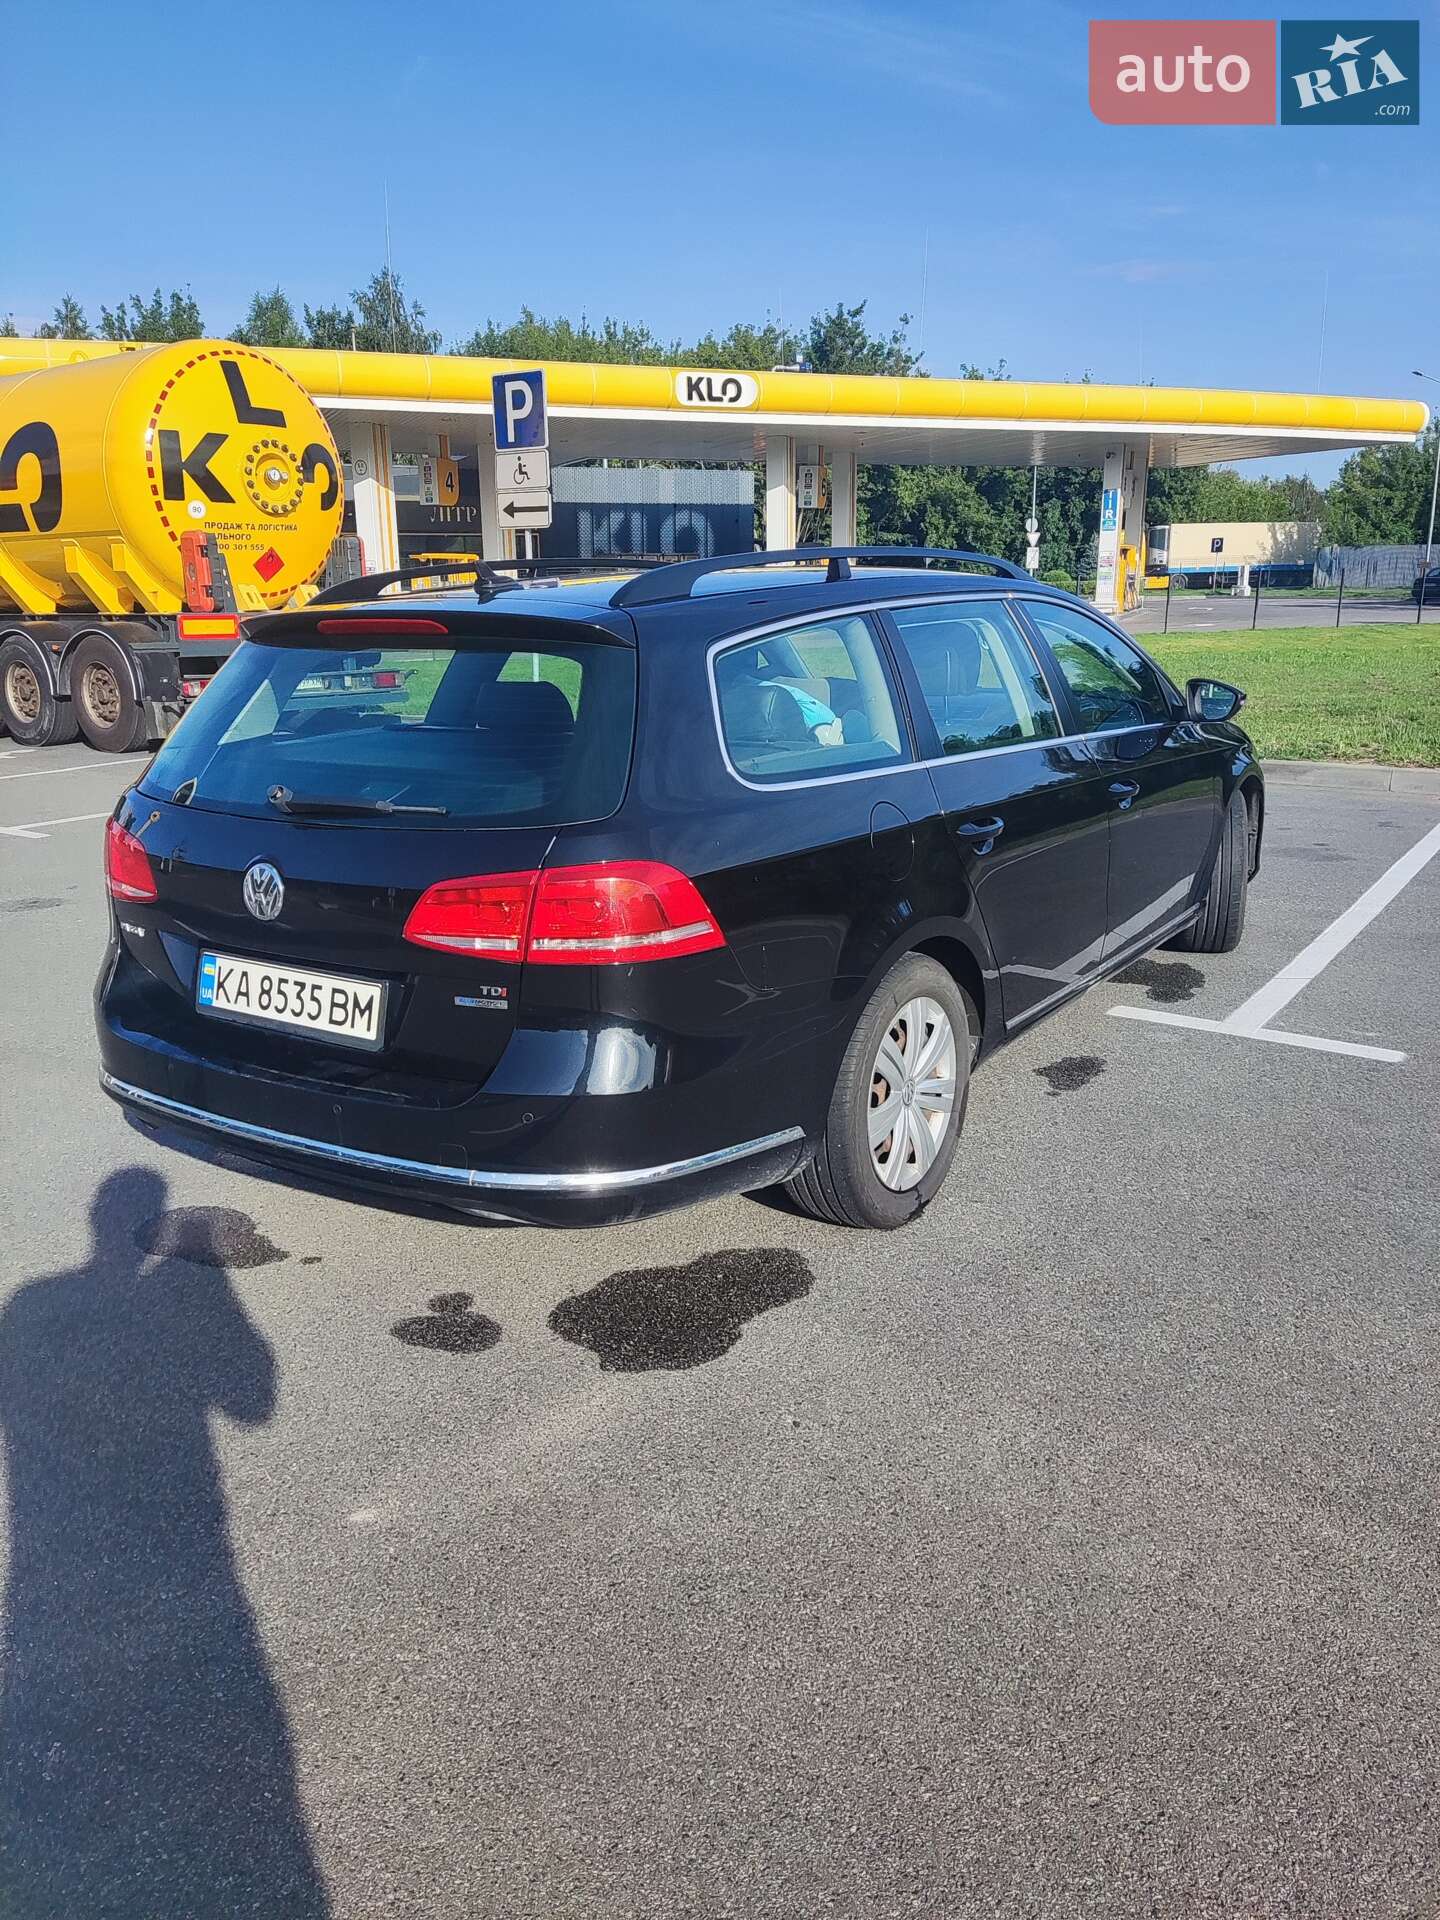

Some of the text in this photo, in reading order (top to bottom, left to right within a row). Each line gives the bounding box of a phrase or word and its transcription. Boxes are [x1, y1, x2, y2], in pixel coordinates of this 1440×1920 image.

[686, 376, 742, 403] KLO
[504, 380, 533, 443] P
[445, 471, 455, 493] 4
[204, 522, 298, 532] ПРОДАЖ ТА ЛОГІСТИКА
[216, 532, 252, 541] ЛЬНОГО
[1213, 538, 1222, 550] P
[202, 988, 212, 999] UA
[258, 975, 323, 1021] 8535
